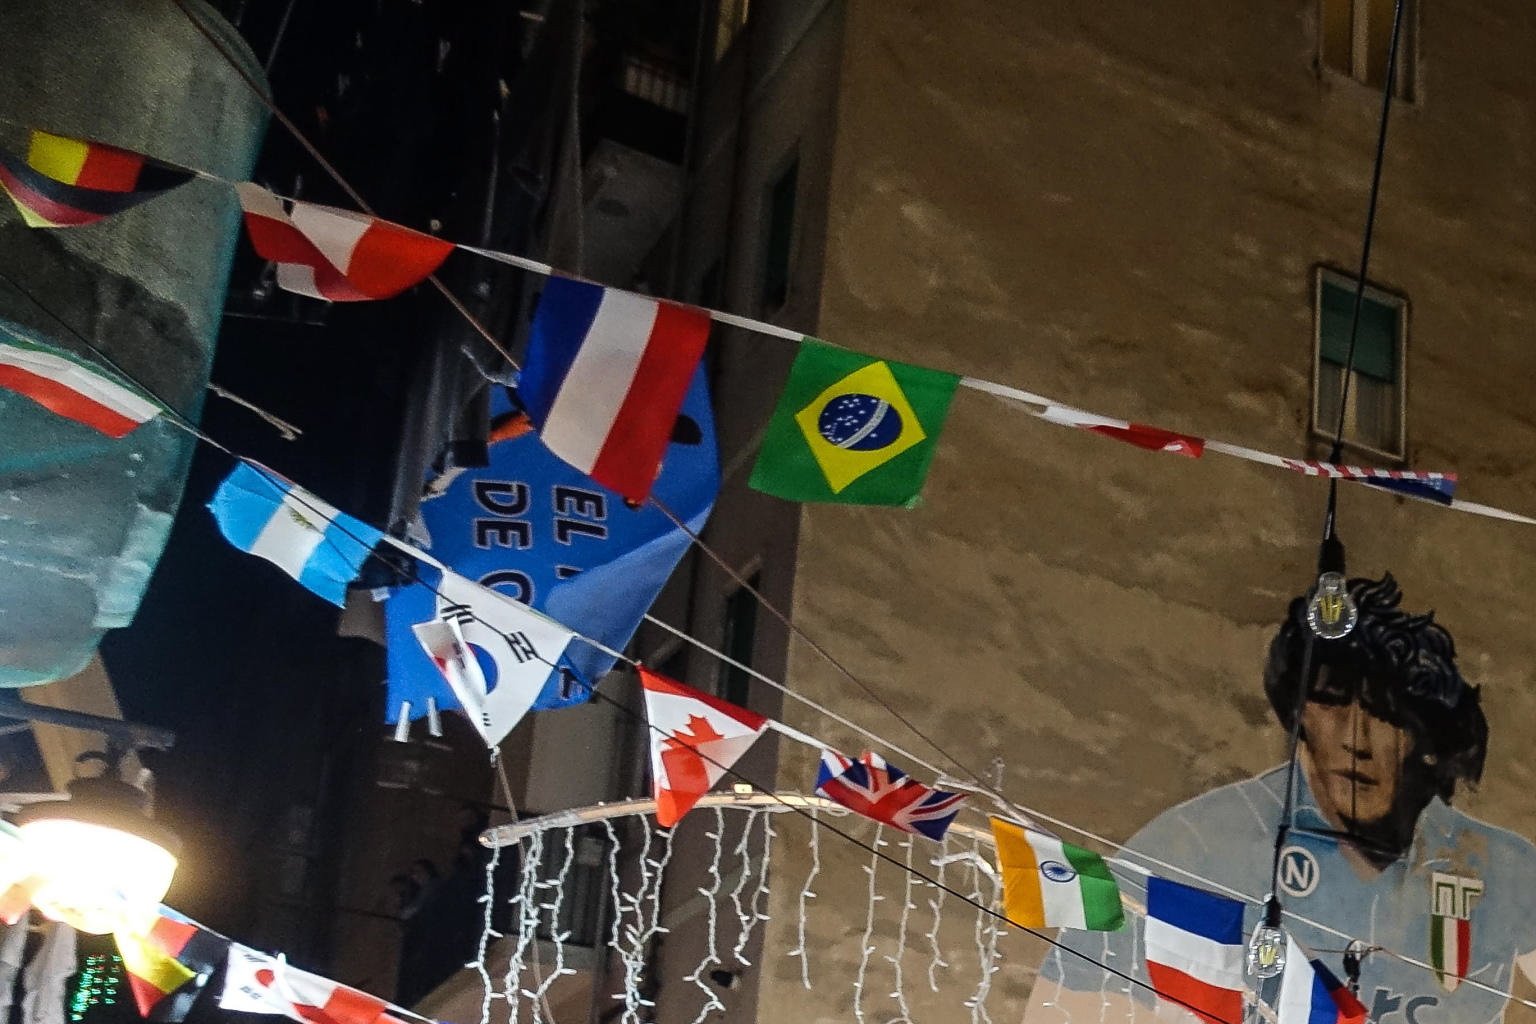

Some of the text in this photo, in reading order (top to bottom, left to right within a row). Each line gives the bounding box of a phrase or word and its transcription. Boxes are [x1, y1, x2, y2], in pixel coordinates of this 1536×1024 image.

[472, 479, 532, 551] DE
[552, 484, 609, 546] EL
[1283, 853, 1313, 890] N
